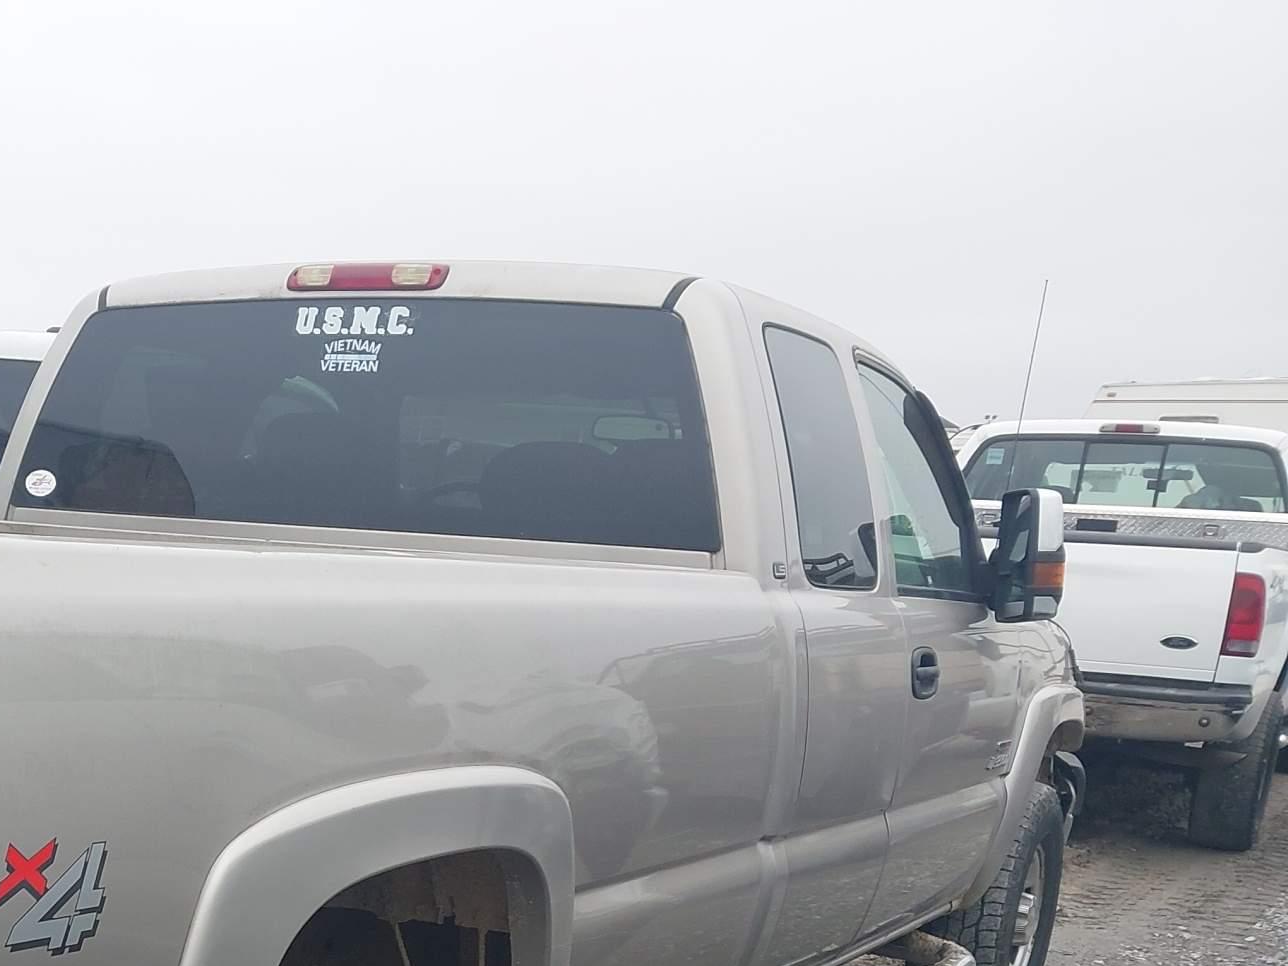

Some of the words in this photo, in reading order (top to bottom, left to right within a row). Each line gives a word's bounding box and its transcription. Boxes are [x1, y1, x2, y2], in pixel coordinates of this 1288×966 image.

[295, 306, 414, 335] U.S.M.C.
[324, 339, 382, 354] VIETNAM
[320, 360, 379, 372] VETERAN
